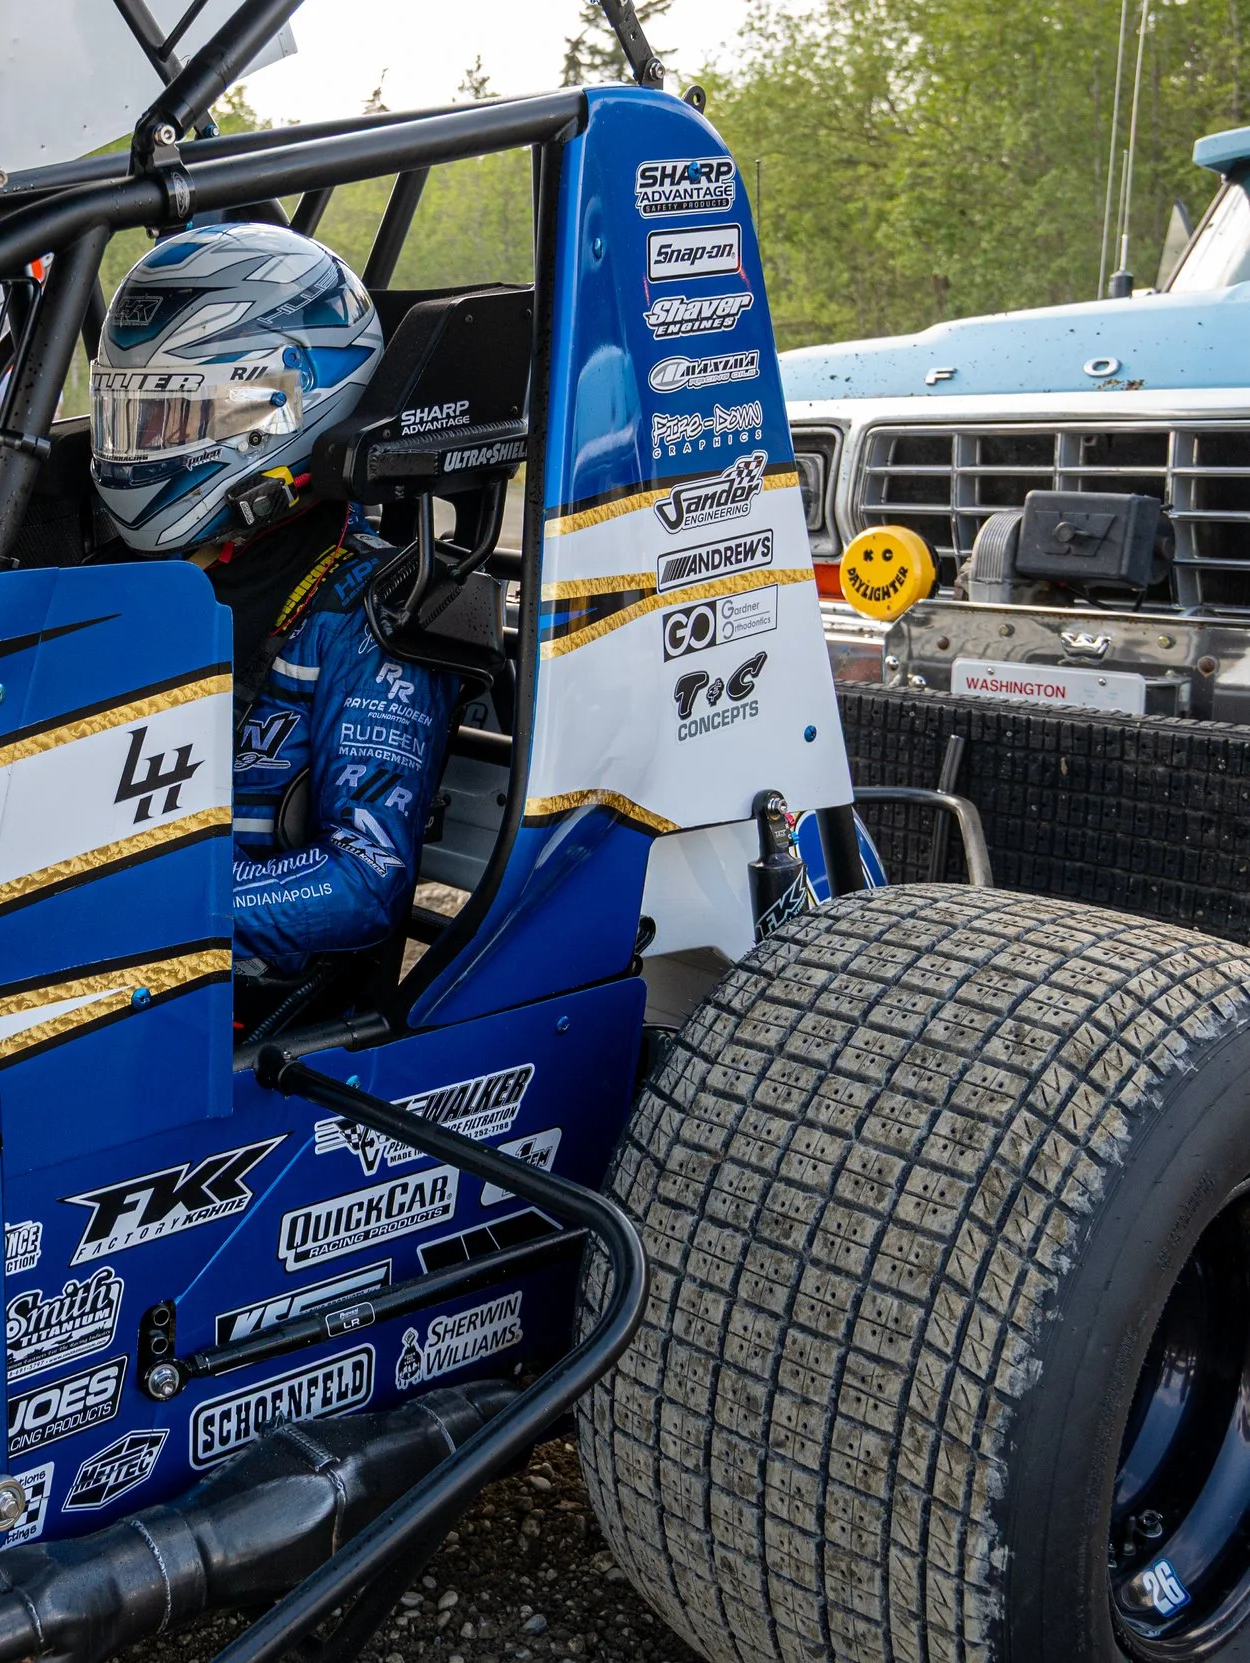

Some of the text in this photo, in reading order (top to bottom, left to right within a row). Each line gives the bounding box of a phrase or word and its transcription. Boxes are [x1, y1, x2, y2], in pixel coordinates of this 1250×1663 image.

[639, 161, 733, 189] SHARP
[640, 184, 733, 204] ADVANTAGE
[645, 198, 728, 213] SAFETY PRODUCTS
[653, 242, 734, 267] Snap-on
[650, 295, 751, 325] Shaver
[658, 316, 735, 337] ENGINES
[680, 352, 757, 378] MAXIMA
[688, 372, 730, 387] RACING
[401, 400, 470, 426] SHARP
[402, 416, 470, 436] ADVANTAGE
[652, 430, 763, 459] GRAPHICS
[683, 504, 749, 526] ENGINEERING
[686, 536, 771, 578] ANDREWS
[847, 566, 909, 601] DAYLIGHTER
[721, 599, 761, 620] Gardner
[665, 605, 715, 656] GO
[722, 615, 771, 641] Orthodontics
[966, 676, 1066, 699] WASHINGTON
[344, 697, 433, 727] RAYCE RUDEEN
[368, 711, 411, 725] FOUNDATION
[678, 700, 759, 742] CONCEPTS
[340, 722, 426, 758] RUDEEN
[339, 746, 422, 772] MANAGEMENT
[423, 1068, 532, 1124] WALKER
[462, 1105, 518, 1132] FILTRATION
[390, 1152, 413, 1164] MADE
[75, 1216, 183, 1261] FACTORY
[182, 1197, 247, 1227] KAHNE
[308, 1206, 443, 1258] RACING PRODUCTS
[8, 1270, 114, 1338] Smith
[20, 1307, 111, 1347] TITANIUM
[343, 1318, 361, 1330] LR
[428, 1295, 519, 1348] SHERWIN
[425, 1322, 518, 1376] WILLIAMS
[8, 1366, 119, 1438] JOES
[202, 1359, 366, 1454] SCHOENFELD
[44, 1401, 113, 1438] PRODUCTS
[1142, 1560, 1186, 1615] 26
